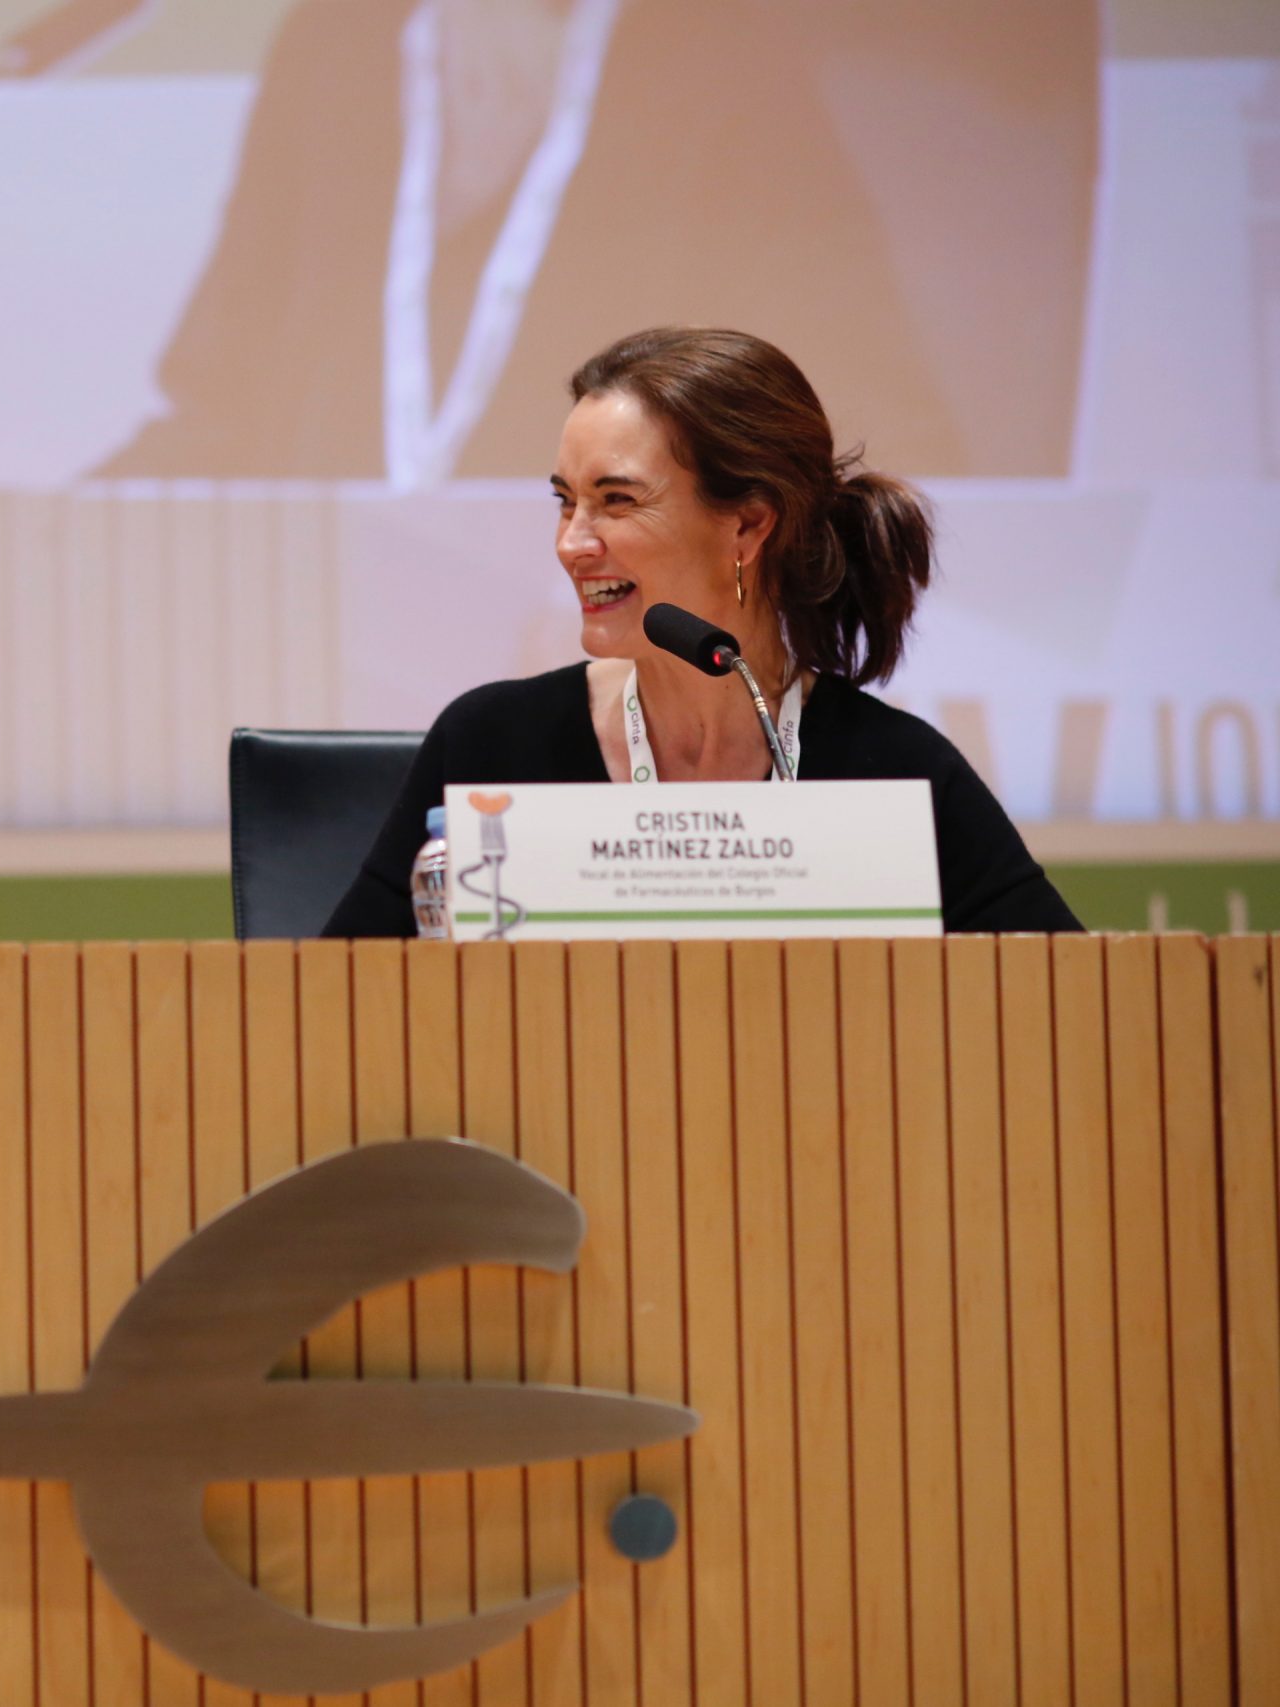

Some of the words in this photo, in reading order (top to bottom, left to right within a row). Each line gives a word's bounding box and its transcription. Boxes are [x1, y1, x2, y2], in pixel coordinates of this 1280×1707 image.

[635, 812, 745, 832] CRISTINA
[592, 833, 710, 859] MARTÍNEZ
[718, 837, 794, 859] ZALDO
[613, 868, 626, 879] de
[615, 886, 628, 897] de
[718, 886, 731, 897] de
